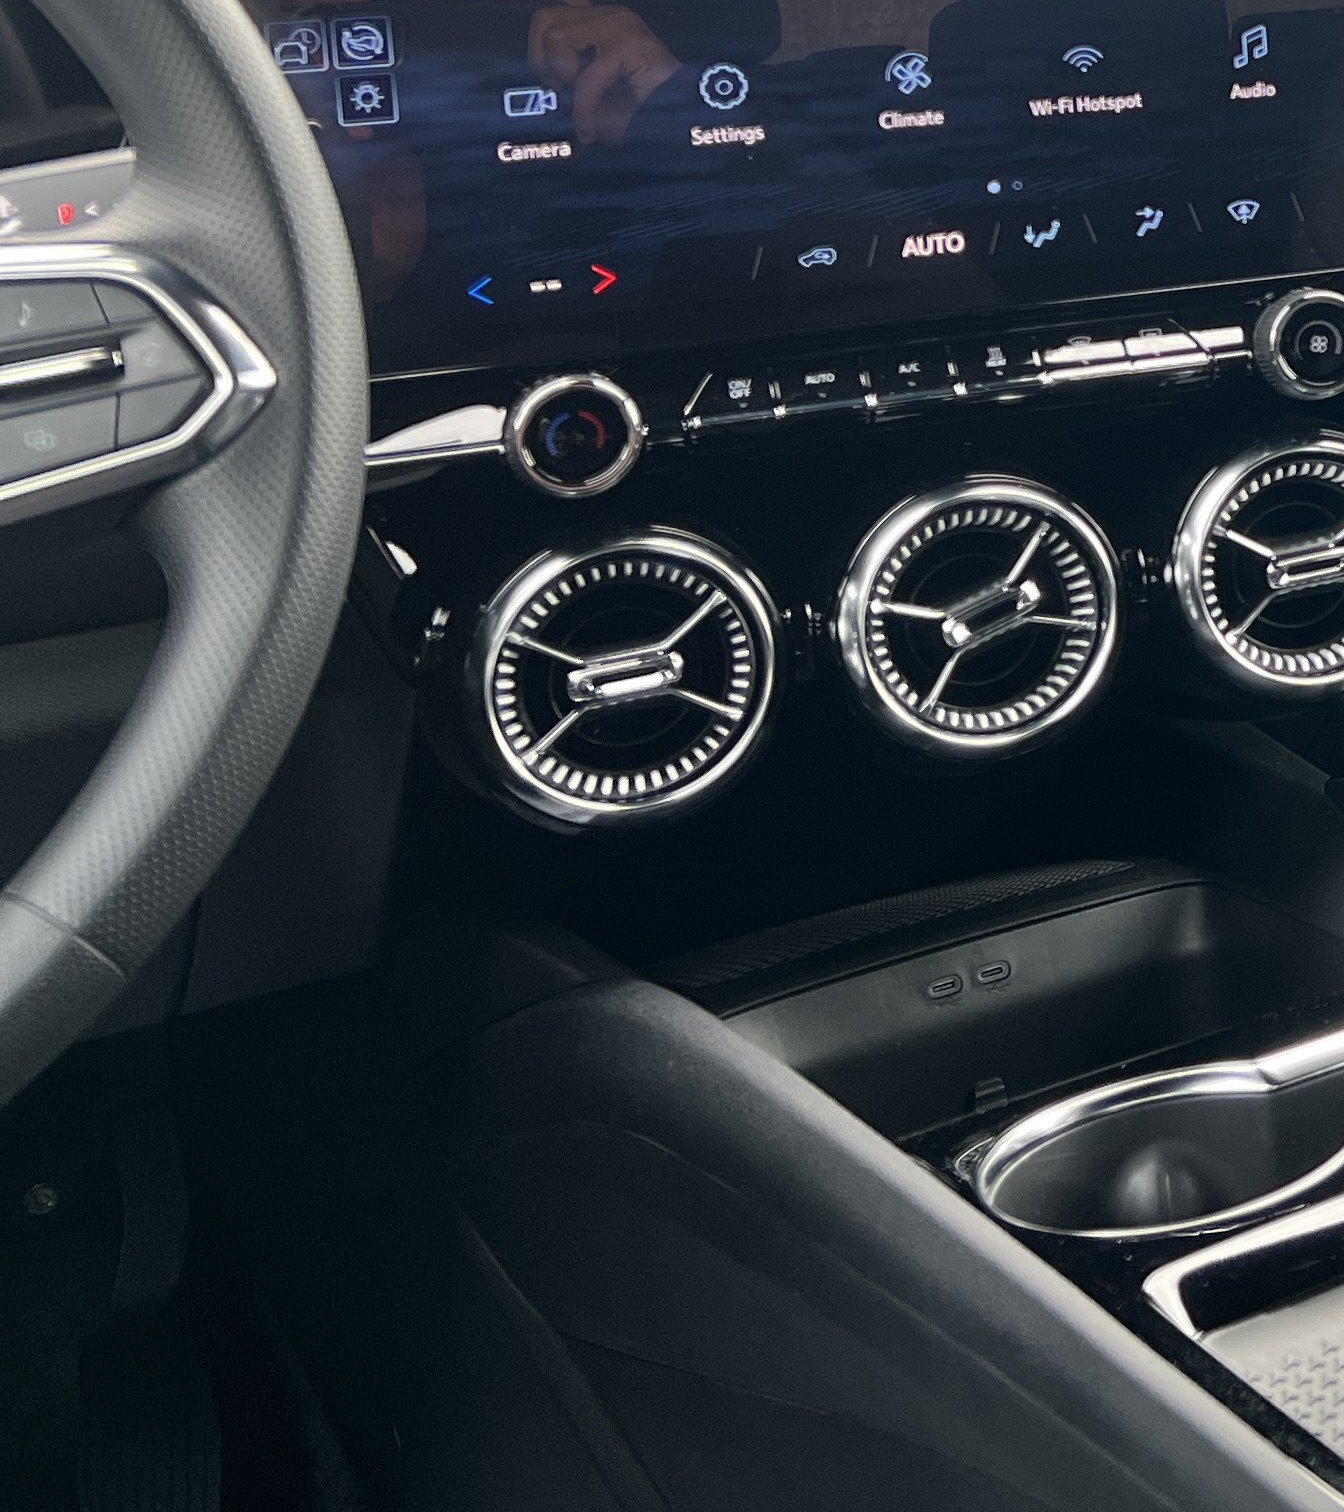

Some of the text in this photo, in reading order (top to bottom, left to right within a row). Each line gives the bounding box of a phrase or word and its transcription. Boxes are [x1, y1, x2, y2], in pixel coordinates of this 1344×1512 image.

[1230, 81, 1277, 100] Audio
[1028, 91, 1143, 118] Wi-Fi Hotspot
[879, 108, 944, 130] Climate
[690, 123, 766, 146] Settings
[497, 140, 572, 162] Camera
[901, 230, 966, 258] AUTO
[805, 372, 836, 385] AUTO
[899, 362, 921, 374] A/C
